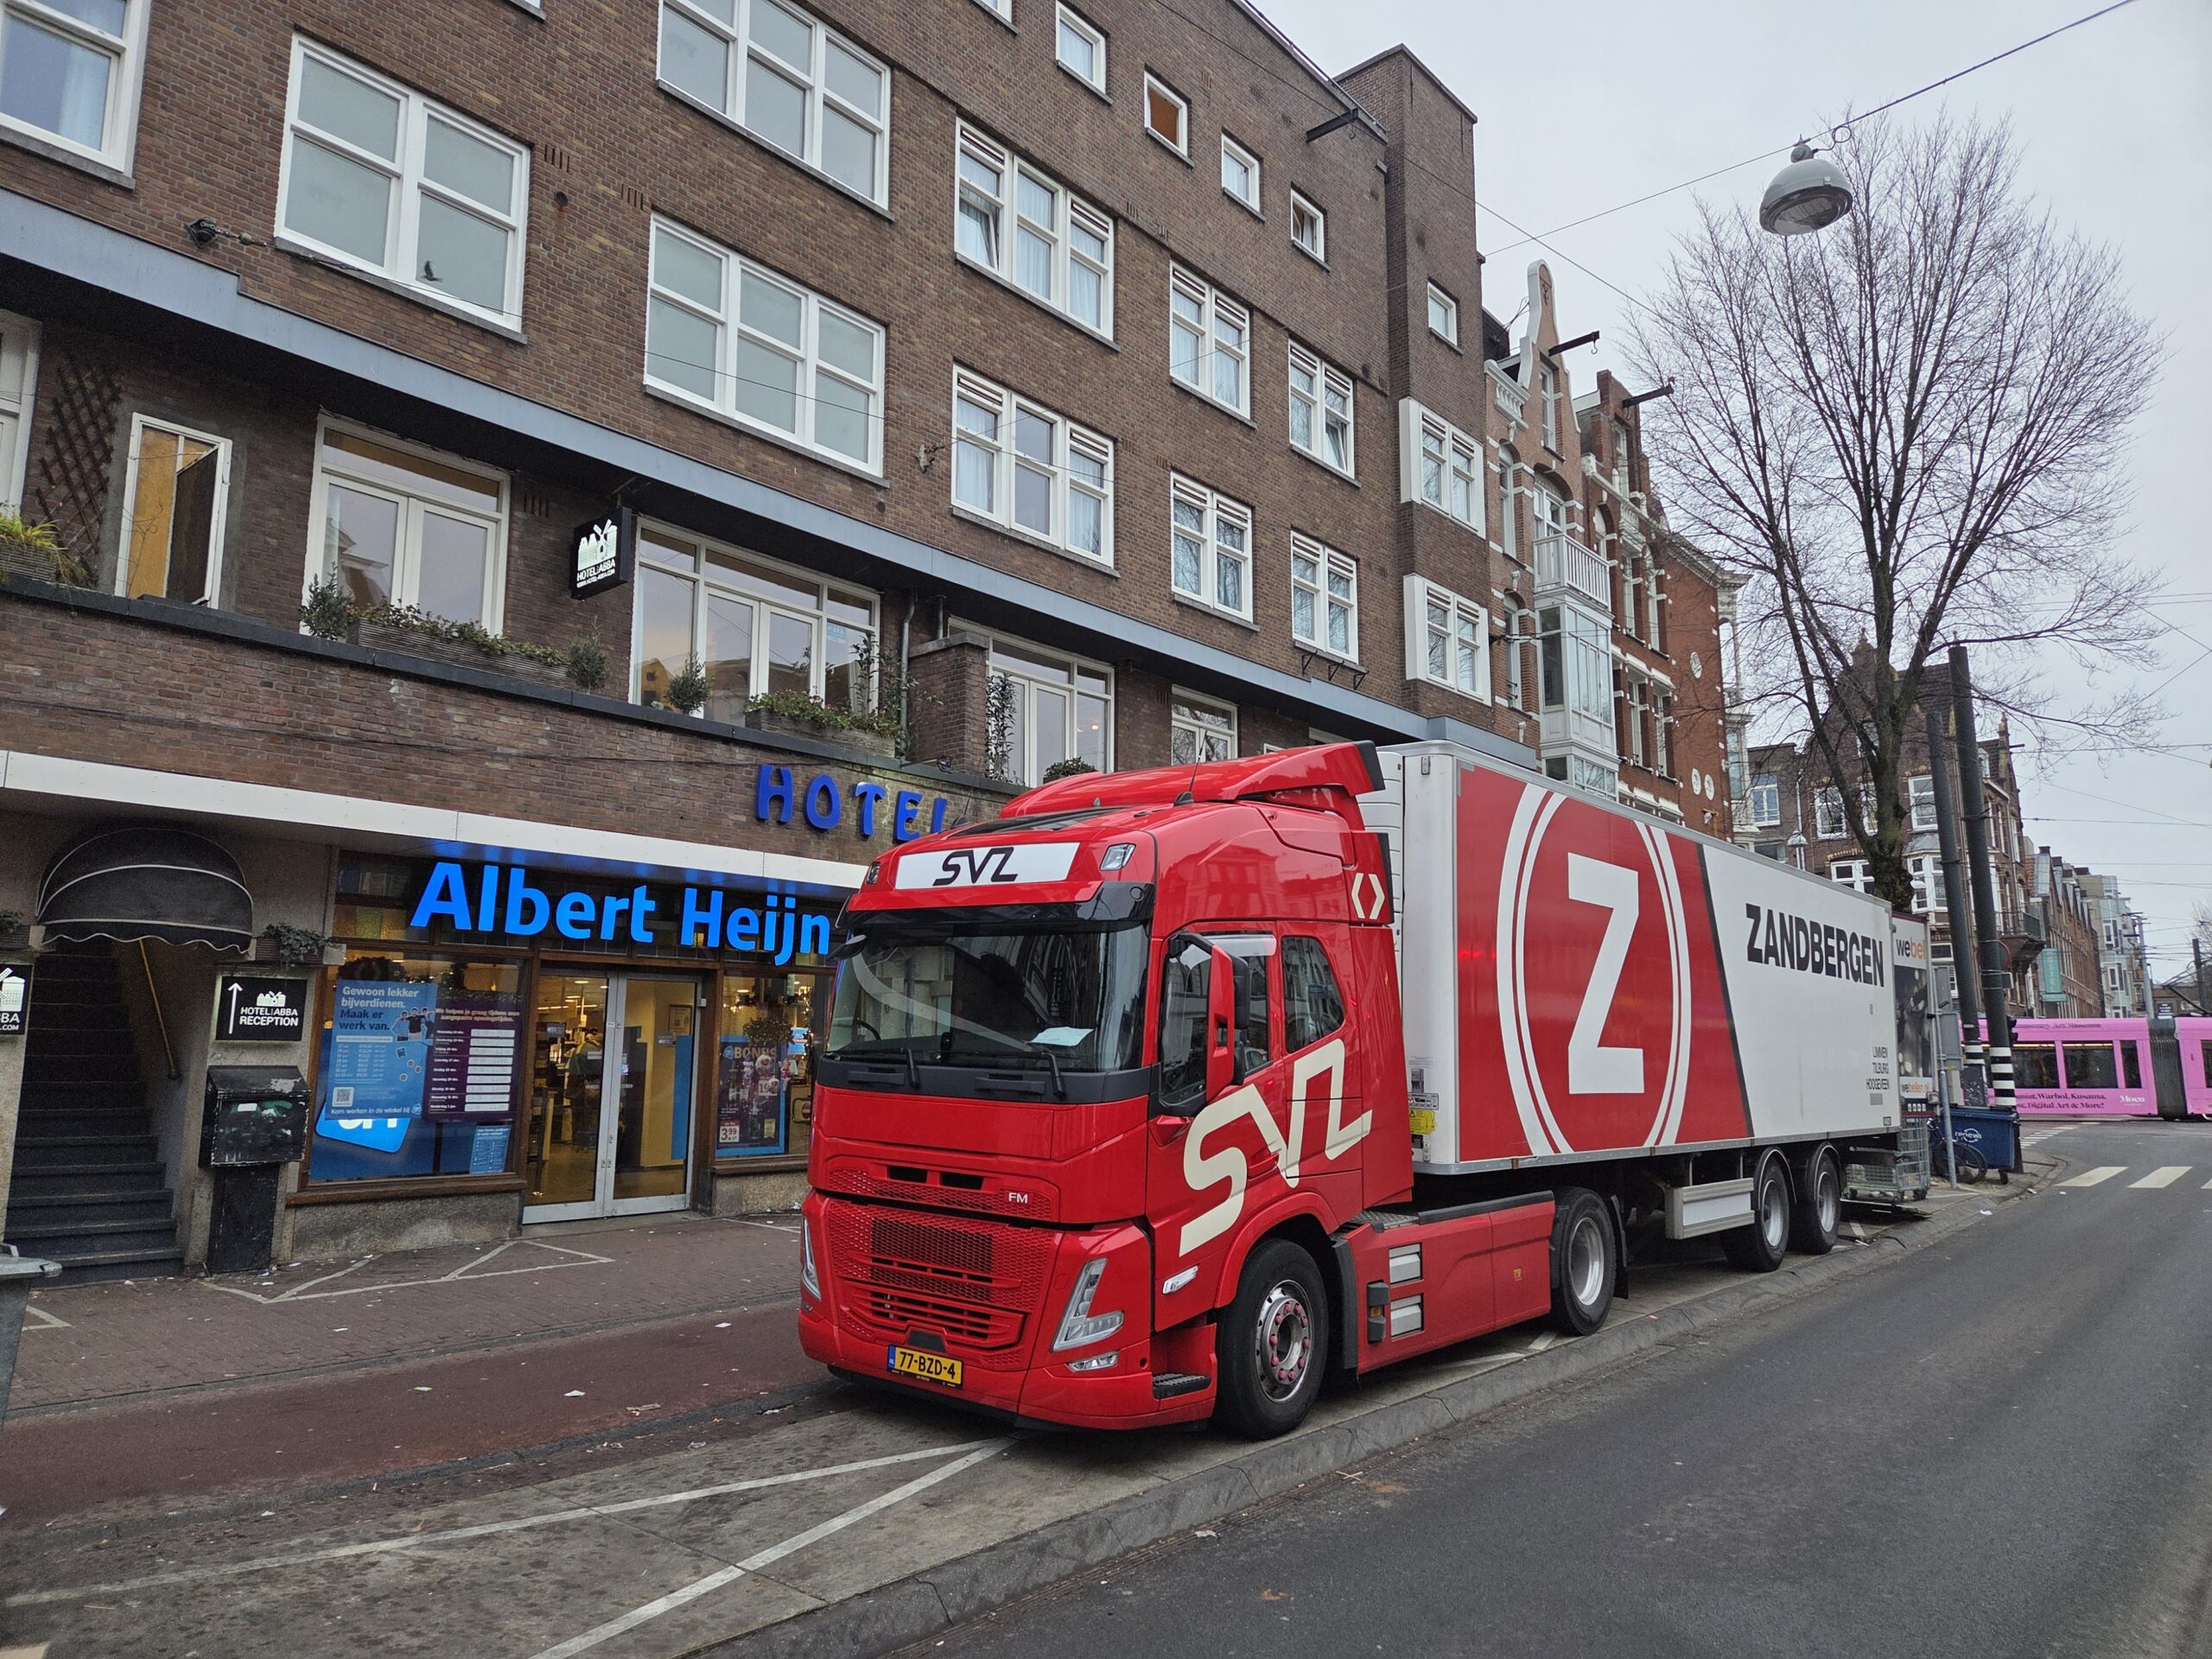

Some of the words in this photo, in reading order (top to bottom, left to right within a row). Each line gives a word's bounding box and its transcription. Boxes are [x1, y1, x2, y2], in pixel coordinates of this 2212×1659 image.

[576, 566, 596, 582] HOTEL
[598, 558, 616, 574] ABBA
[932, 847, 1018, 887] SVZ
[410, 861, 655, 944] Albert
[680, 887, 830, 965] Heijn
[1745, 902, 1885, 988] ZANDBERGEN
[1567, 852, 1645, 1095] Z
[342, 986, 385, 996] Gewoon
[387, 988, 419, 998] lekker
[340, 997, 406, 1008] bijverdienen.
[240, 1007, 271, 1015] HOTEL
[273, 1007, 298, 1016] ABBA
[340, 1009, 370, 1019] Maak
[0, 1013, 21, 1024] BA
[239, 1016, 299, 1027] RECEPTION
[339, 1021, 366, 1030] werk
[1179, 1039, 1373, 1258] SVZ
[1008, 1192, 1028, 1204] FM
[899, 1351, 956, 1380] 77-BZD-4
